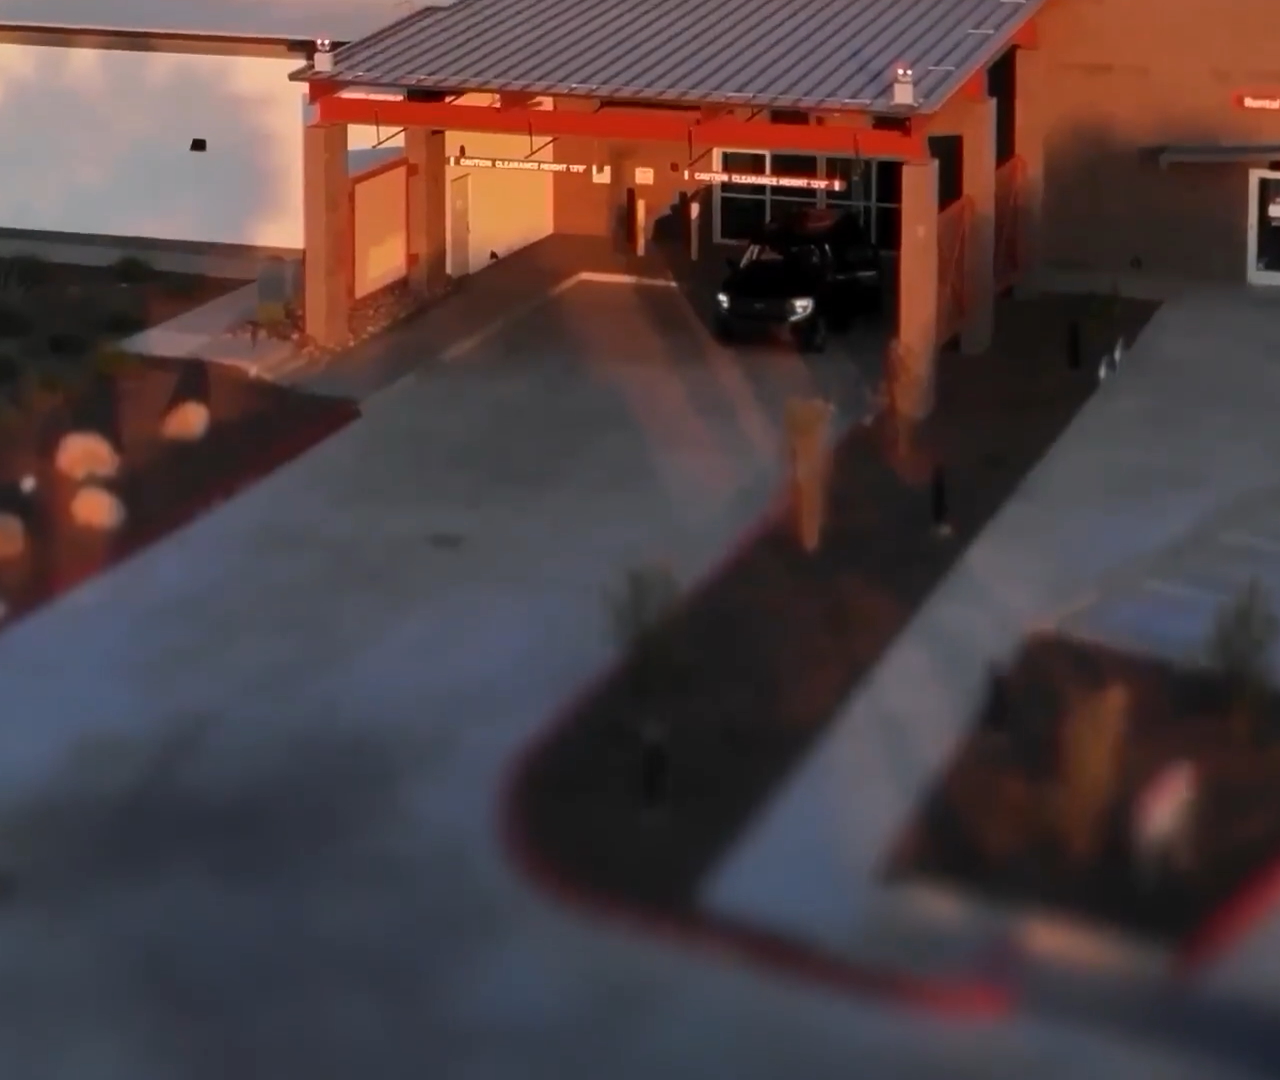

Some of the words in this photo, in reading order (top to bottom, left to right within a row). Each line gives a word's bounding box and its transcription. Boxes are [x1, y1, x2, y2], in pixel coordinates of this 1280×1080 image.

[1244, 97, 1280, 109] Rental
[460, 158, 492, 167] CAUTION
[495, 160, 539, 170] CLEARANCE
[694, 172, 728, 182] CAUTION
[732, 174, 777, 185] CLEARANCE
